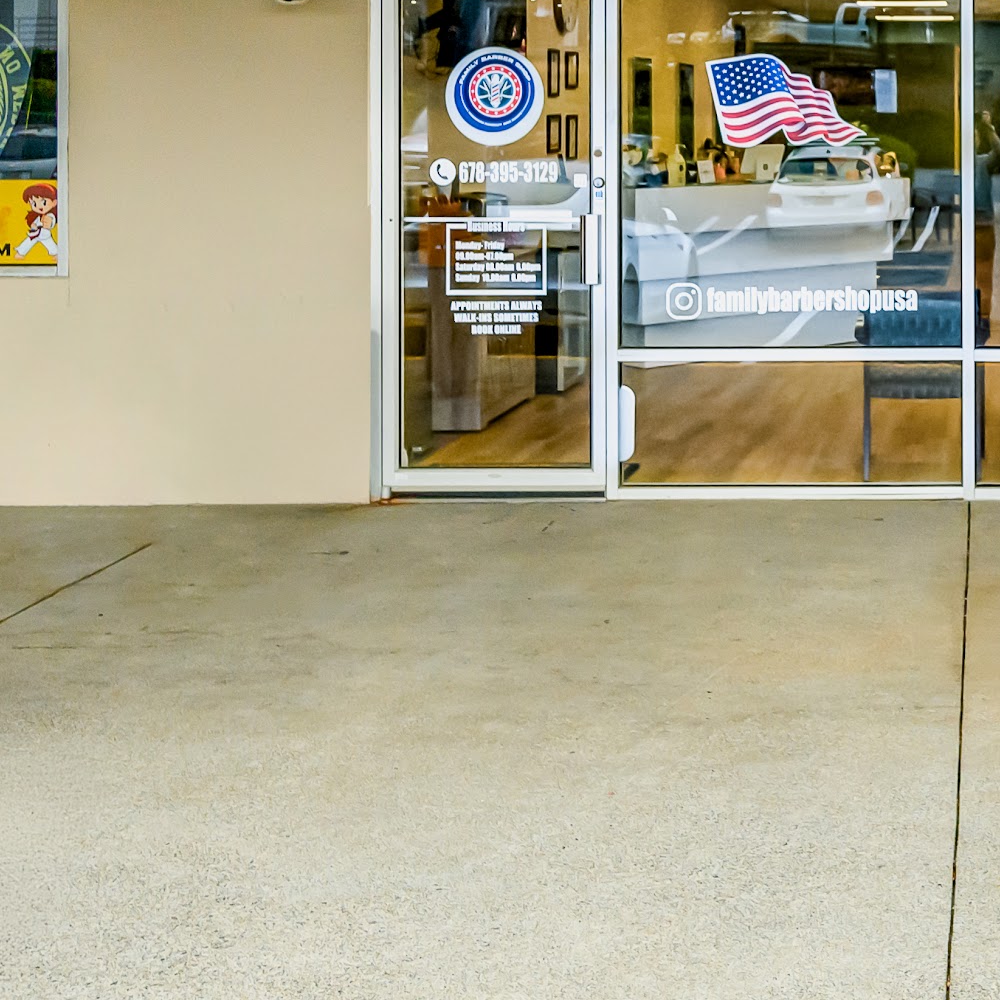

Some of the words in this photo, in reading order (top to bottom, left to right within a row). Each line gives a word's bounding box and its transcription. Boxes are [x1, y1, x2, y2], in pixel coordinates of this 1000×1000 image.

[459, 58, 479, 85] FAMILY
[480, 54, 515, 64] BARBER
[458, 160, 559, 184] 678-395-3129
[450, 301, 510, 311] APPOINTMENTS
[510, 301, 543, 311] ALWAYS
[706, 285, 918, 315] familybarbershopusa
[454, 313, 493, 323] WALK-INS
[493, 313, 539, 323] SOMETIMES
[471, 324, 493, 335] BOOK
[494, 324, 522, 335] ONLINE
